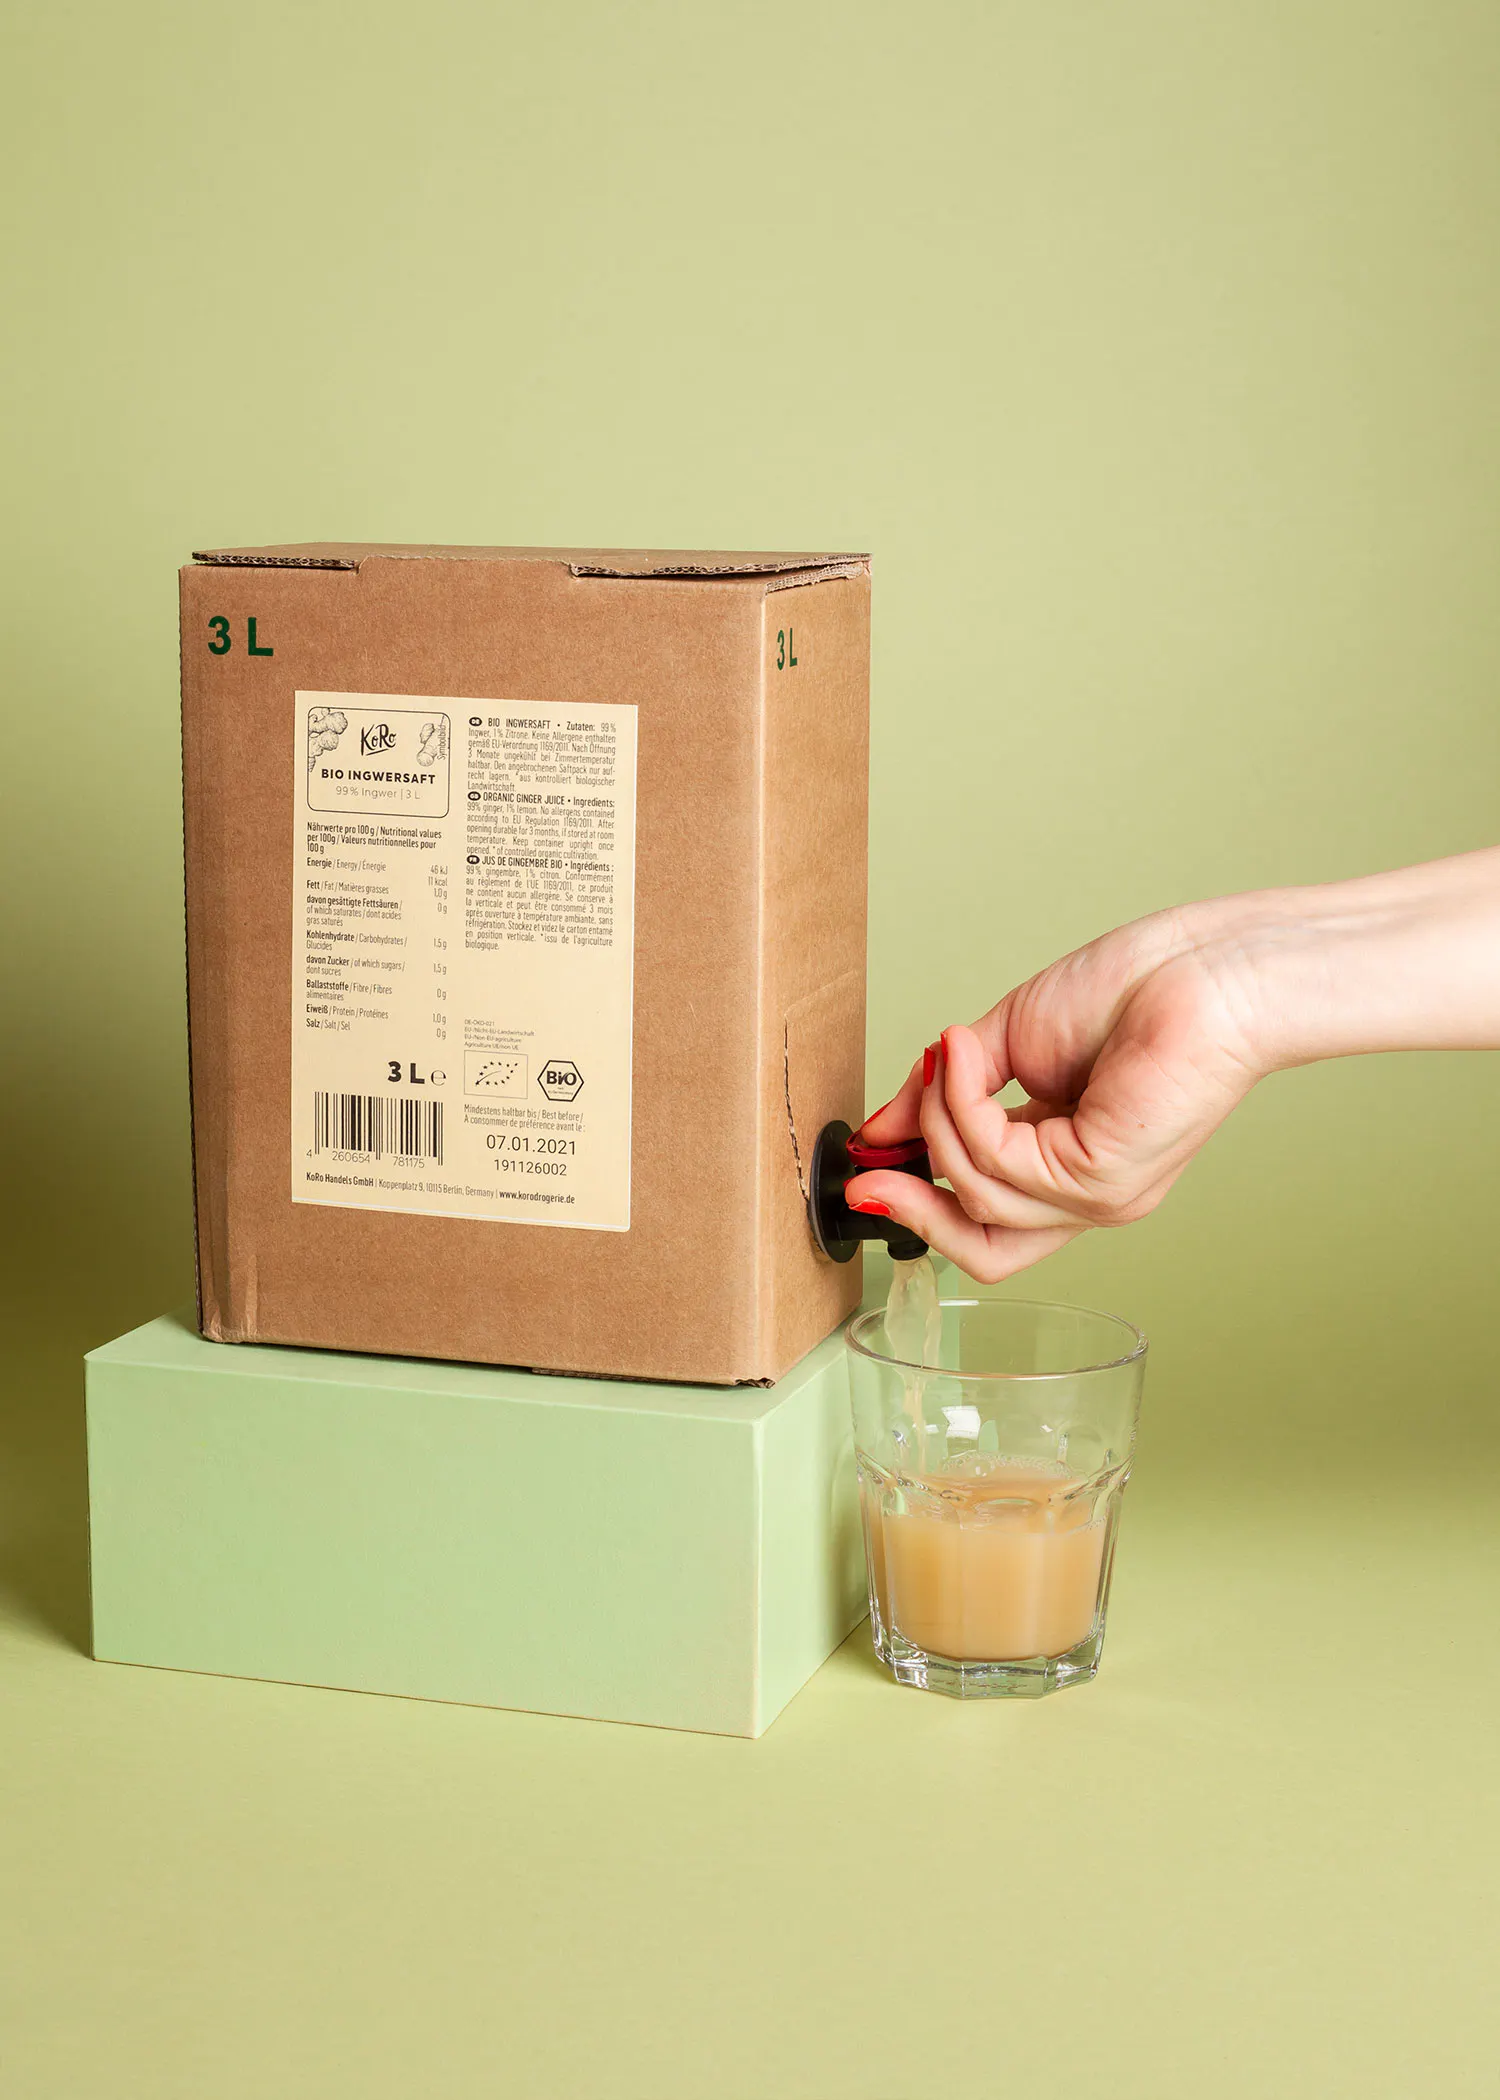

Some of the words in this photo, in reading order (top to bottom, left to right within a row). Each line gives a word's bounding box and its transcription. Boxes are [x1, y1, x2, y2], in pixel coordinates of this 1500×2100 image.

[208, 616, 231, 655] 3
[248, 617, 274, 656] L
[777, 630, 785, 670] 3
[790, 628, 797, 667] L
[488, 718, 500, 727] BIO
[506, 718, 551, 729] INGWERSAFT
[566, 721, 595, 731] Zutaten:
[360, 724, 396, 756] KoRo
[532, 731, 549, 740] Keine
[552, 732, 582, 743] Allergene
[585, 733, 616, 743] enthalten
[492, 740, 538, 752] EU-Verordnung
[572, 743, 588, 752] Nach
[322, 769, 343, 779] BIO
[348, 770, 436, 784] INGWERSAFT
[362, 788, 397, 799] Ingwer
[406, 790, 411, 799] 3
[415, 790, 420, 799] L
[483, 792, 514, 803] ORGANIC
[516, 794, 542, 804] GINGER
[544, 795, 564, 805] JUICE
[573, 796, 615, 808] Ingredients:
[541, 806, 549, 815] No
[551, 806, 580, 818] allergens
[583, 808, 615, 818] contained
[467, 814, 498, 825] according
[502, 815, 509, 824] to
[513, 815, 521, 824] EU
[525, 816, 559, 827] Regulation
[598, 819, 614, 828] After
[307, 822, 343, 833] Nährwerte
[344, 826, 356, 835] pro
[357, 825, 369, 834] 100
[380, 826, 418, 837] Nutritional
[420, 829, 442, 838] values
[307, 834, 318, 843] per
[341, 834, 366, 844] Valeurs
[368, 836, 419, 847] nutritionnelles
[420, 841, 436, 850] pour
[307, 843, 319, 852] 100
[307, 857, 332, 869] Energie
[336, 859, 357, 871] Energy
[482, 856, 495, 866] JUS
[497, 857, 506, 866] DE
[508, 857, 549, 868] GINGEMBRE
[551, 860, 562, 869] BIO
[307, 880, 320, 890] Fett
[324, 881, 334, 891] Fat
[366, 886, 389, 895] grasses
[307, 895, 326, 905] davon
[327, 896, 361, 908] gesättigte
[362, 898, 398, 909] Fettsäuren
[466, 898, 472, 906] la
[475, 899, 502, 908] verticale
[506, 900, 513, 909] et
[516, 901, 531, 911] peut
[590, 904, 594, 913] 3
[598, 905, 613, 914] mois
[307, 905, 313, 914] of
[314, 906, 332, 915] which
[333, 907, 361, 917] saturates
[366, 909, 380, 918] dont
[381, 910, 401, 919] acides
[508, 921, 532, 930] Stockez
[533, 923, 540, 931] et
[542, 923, 558, 932] videz
[559, 924, 564, 932] le
[566, 925, 587, 934] carton
[307, 930, 354, 943] Kohlenhydrate
[359, 933, 403, 946] Carbohydrates
[306, 940, 332, 951] Glucides
[306, 955, 326, 965] davon
[327, 956, 350, 966] Zucker
[354, 958, 361, 967] of
[362, 959, 380, 968] which
[381, 962, 401, 971] sugars
[306, 965, 320, 974] dont
[321, 968, 341, 976] sucres
[306, 979, 349, 991] Ballaststoffe
[353, 982, 369, 993] Fibre
[373, 984, 392, 994] Fibres
[306, 990, 344, 1001] alimentaires
[306, 1004, 328, 1015] Eiweiß
[333, 1006, 355, 1016] Protein
[306, 1018, 320, 1028] Salz
[324, 1020, 336, 1029] Salt
[341, 1021, 351, 1030] Sel
[388, 1061, 401, 1082] 3
[410, 1063, 425, 1084] L
[464, 1104, 501, 1115] Mindestens
[502, 1107, 525, 1117] haltbar
[527, 1109, 537, 1118] bis
[542, 1110, 556, 1119] Best
[558, 1111, 580, 1121] before
[470, 1117, 508, 1126] consommer
[510, 1118, 518, 1127] de
[556, 1123, 574, 1131] avant
[576, 1123, 582, 1132] le
[486, 1135, 575, 1155] 07.01.2021
[306, 1149, 312, 1158] 4
[332, 1151, 370, 1163] 260654
[393, 1156, 424, 1168] 781175
[494, 1159, 567, 1176] 191126002
[306, 1172, 324, 1182] KoRo
[325, 1174, 352, 1185] Handels
[353, 1176, 374, 1187] GmbH
[379, 1179, 417, 1191] Koppenplatz
[427, 1183, 442, 1193] 10115
[465, 1186, 494, 1199] Germany
[499, 1190, 575, 1204] www.korodrogerie.de
